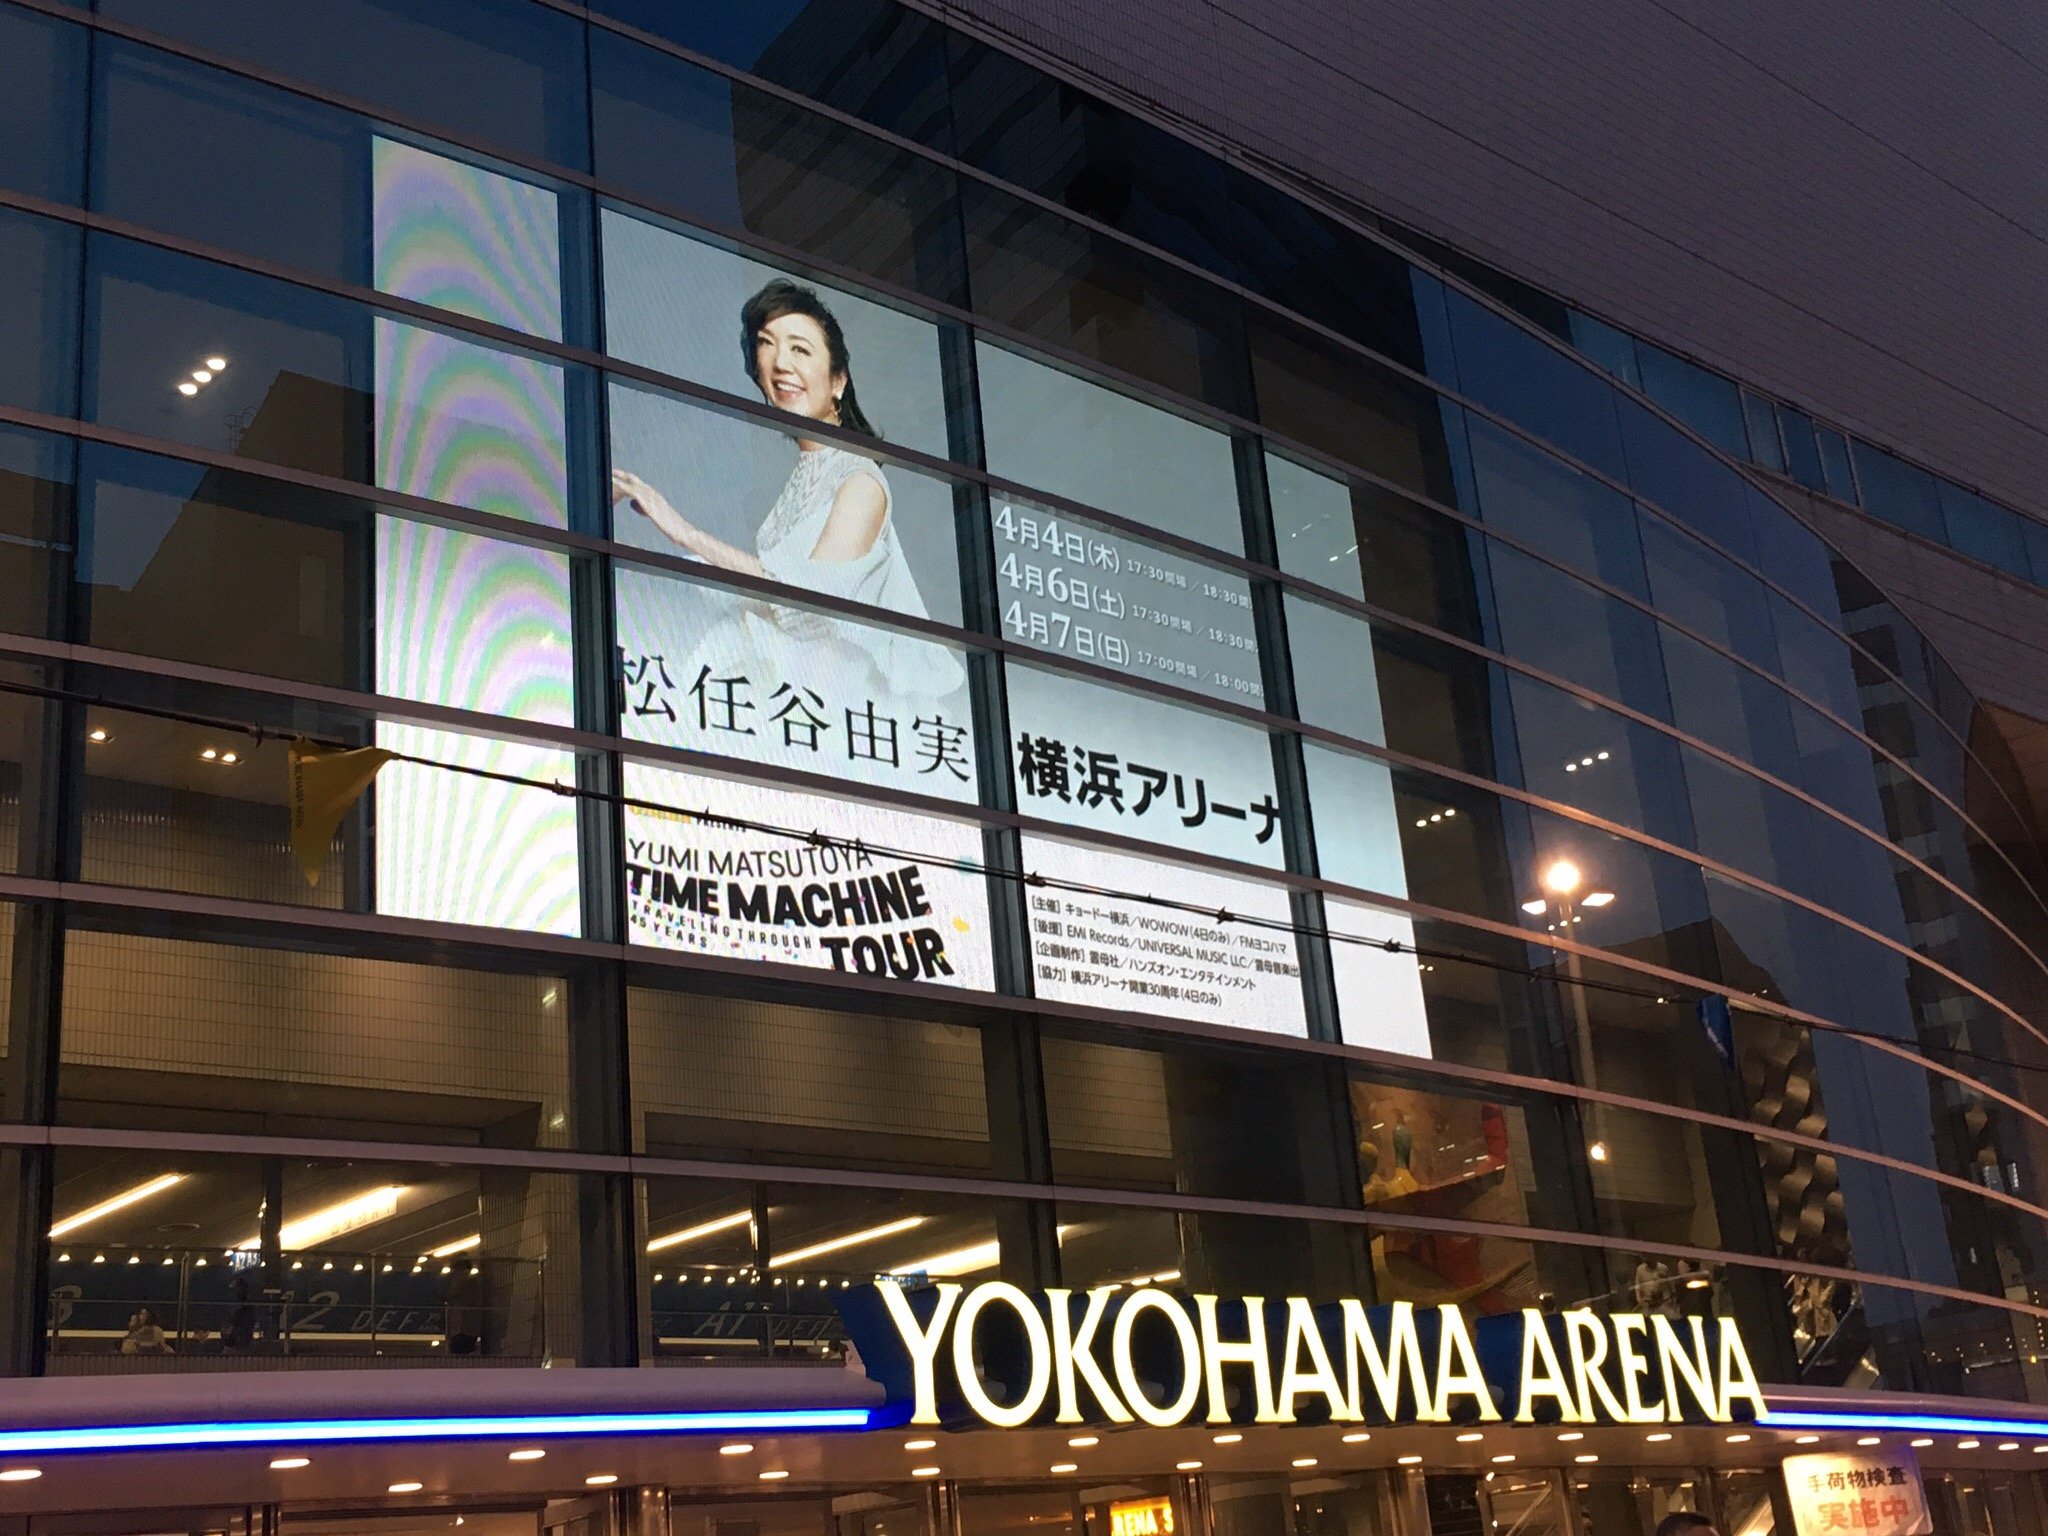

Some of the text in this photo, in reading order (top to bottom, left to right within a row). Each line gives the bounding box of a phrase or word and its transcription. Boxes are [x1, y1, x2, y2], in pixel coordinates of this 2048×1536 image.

[995, 505, 1120, 574] 4月4日(木)
[1000, 552, 1125, 620] 4月6日(土)
[1004, 600, 1130, 666] 4月7日(日)
[621, 651, 971, 783] 松任谷由実
[1017, 732, 1280, 844] 横浜アリーナ
[629, 838, 874, 878] YUMI MATSUTOYA
[625, 863, 932, 928] TIME MACHINE
[652, 922, 707, 949] YEARS
[737, 926, 812, 950] THROUGH
[820, 927, 954, 981] TOUR
[1067, 925, 1087, 940] EMI
[1196, 951, 1228, 963] MUSIC
[874, 1280, 1769, 1428] YOKOHAMA ARENA
[1807, 1466, 1907, 1492] 手荷物検査
[1818, 1496, 1910, 1532] 実施中
